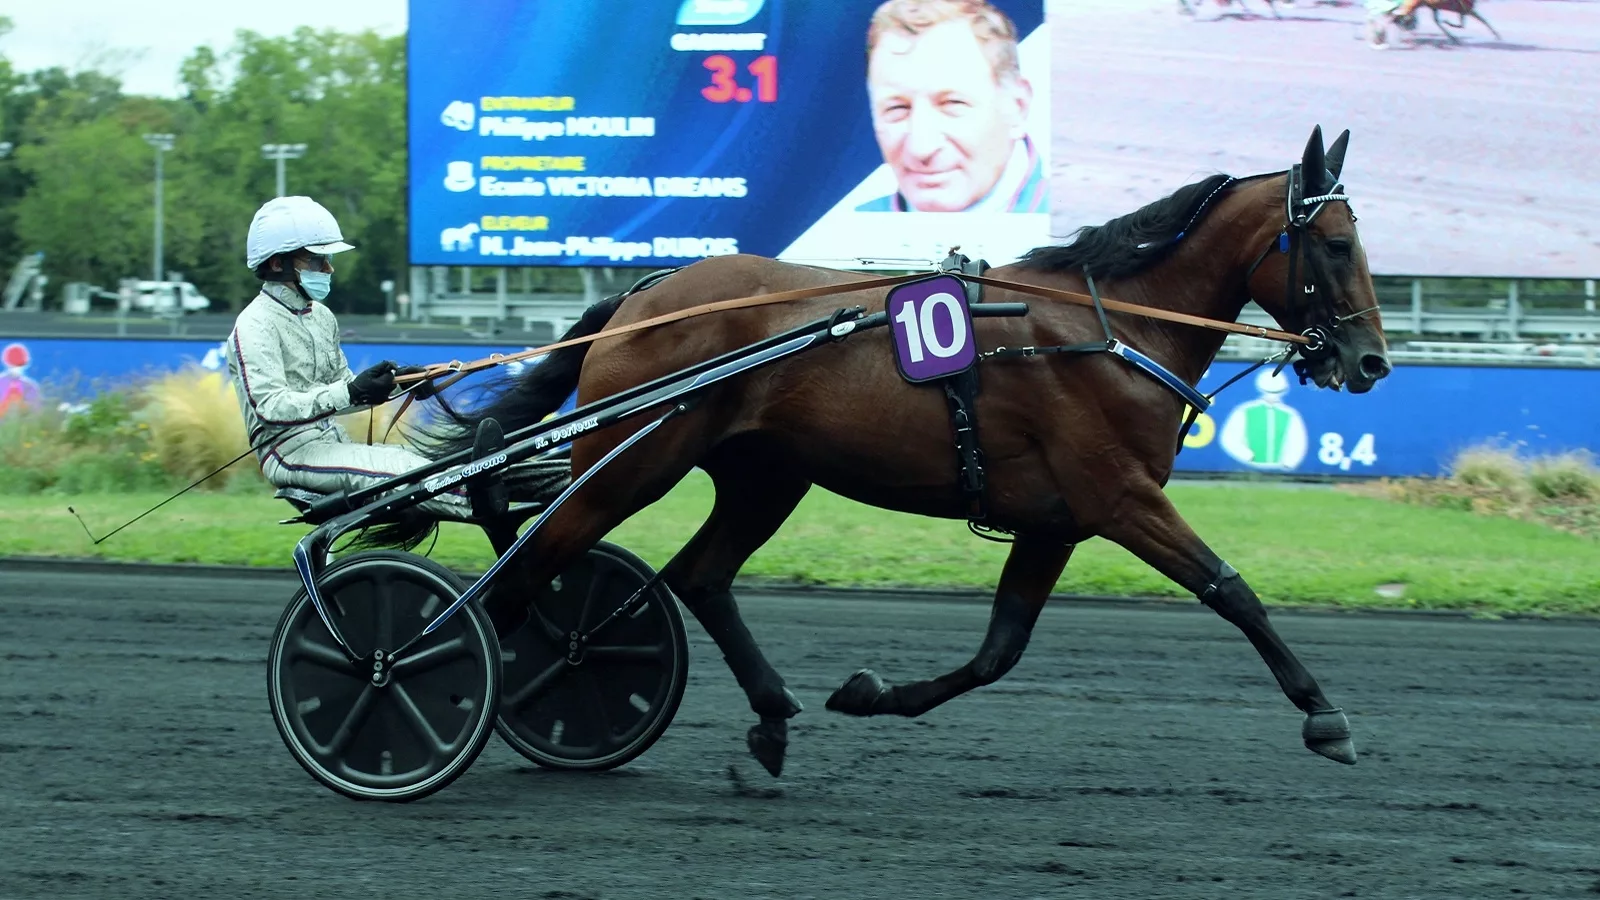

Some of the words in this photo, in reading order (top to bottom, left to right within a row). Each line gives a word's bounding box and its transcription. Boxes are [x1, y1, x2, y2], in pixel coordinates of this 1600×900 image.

[702, 55, 777, 102] 3.1
[566, 117, 655, 137] MOULIN
[547, 177, 652, 197] VICTORIA
[654, 177, 747, 197] DREAMS
[653, 237, 738, 257] DUBOIS
[895, 292, 967, 363] 10
[1318, 433, 1377, 470] 8,4
[461, 453, 507, 478] Chrono
